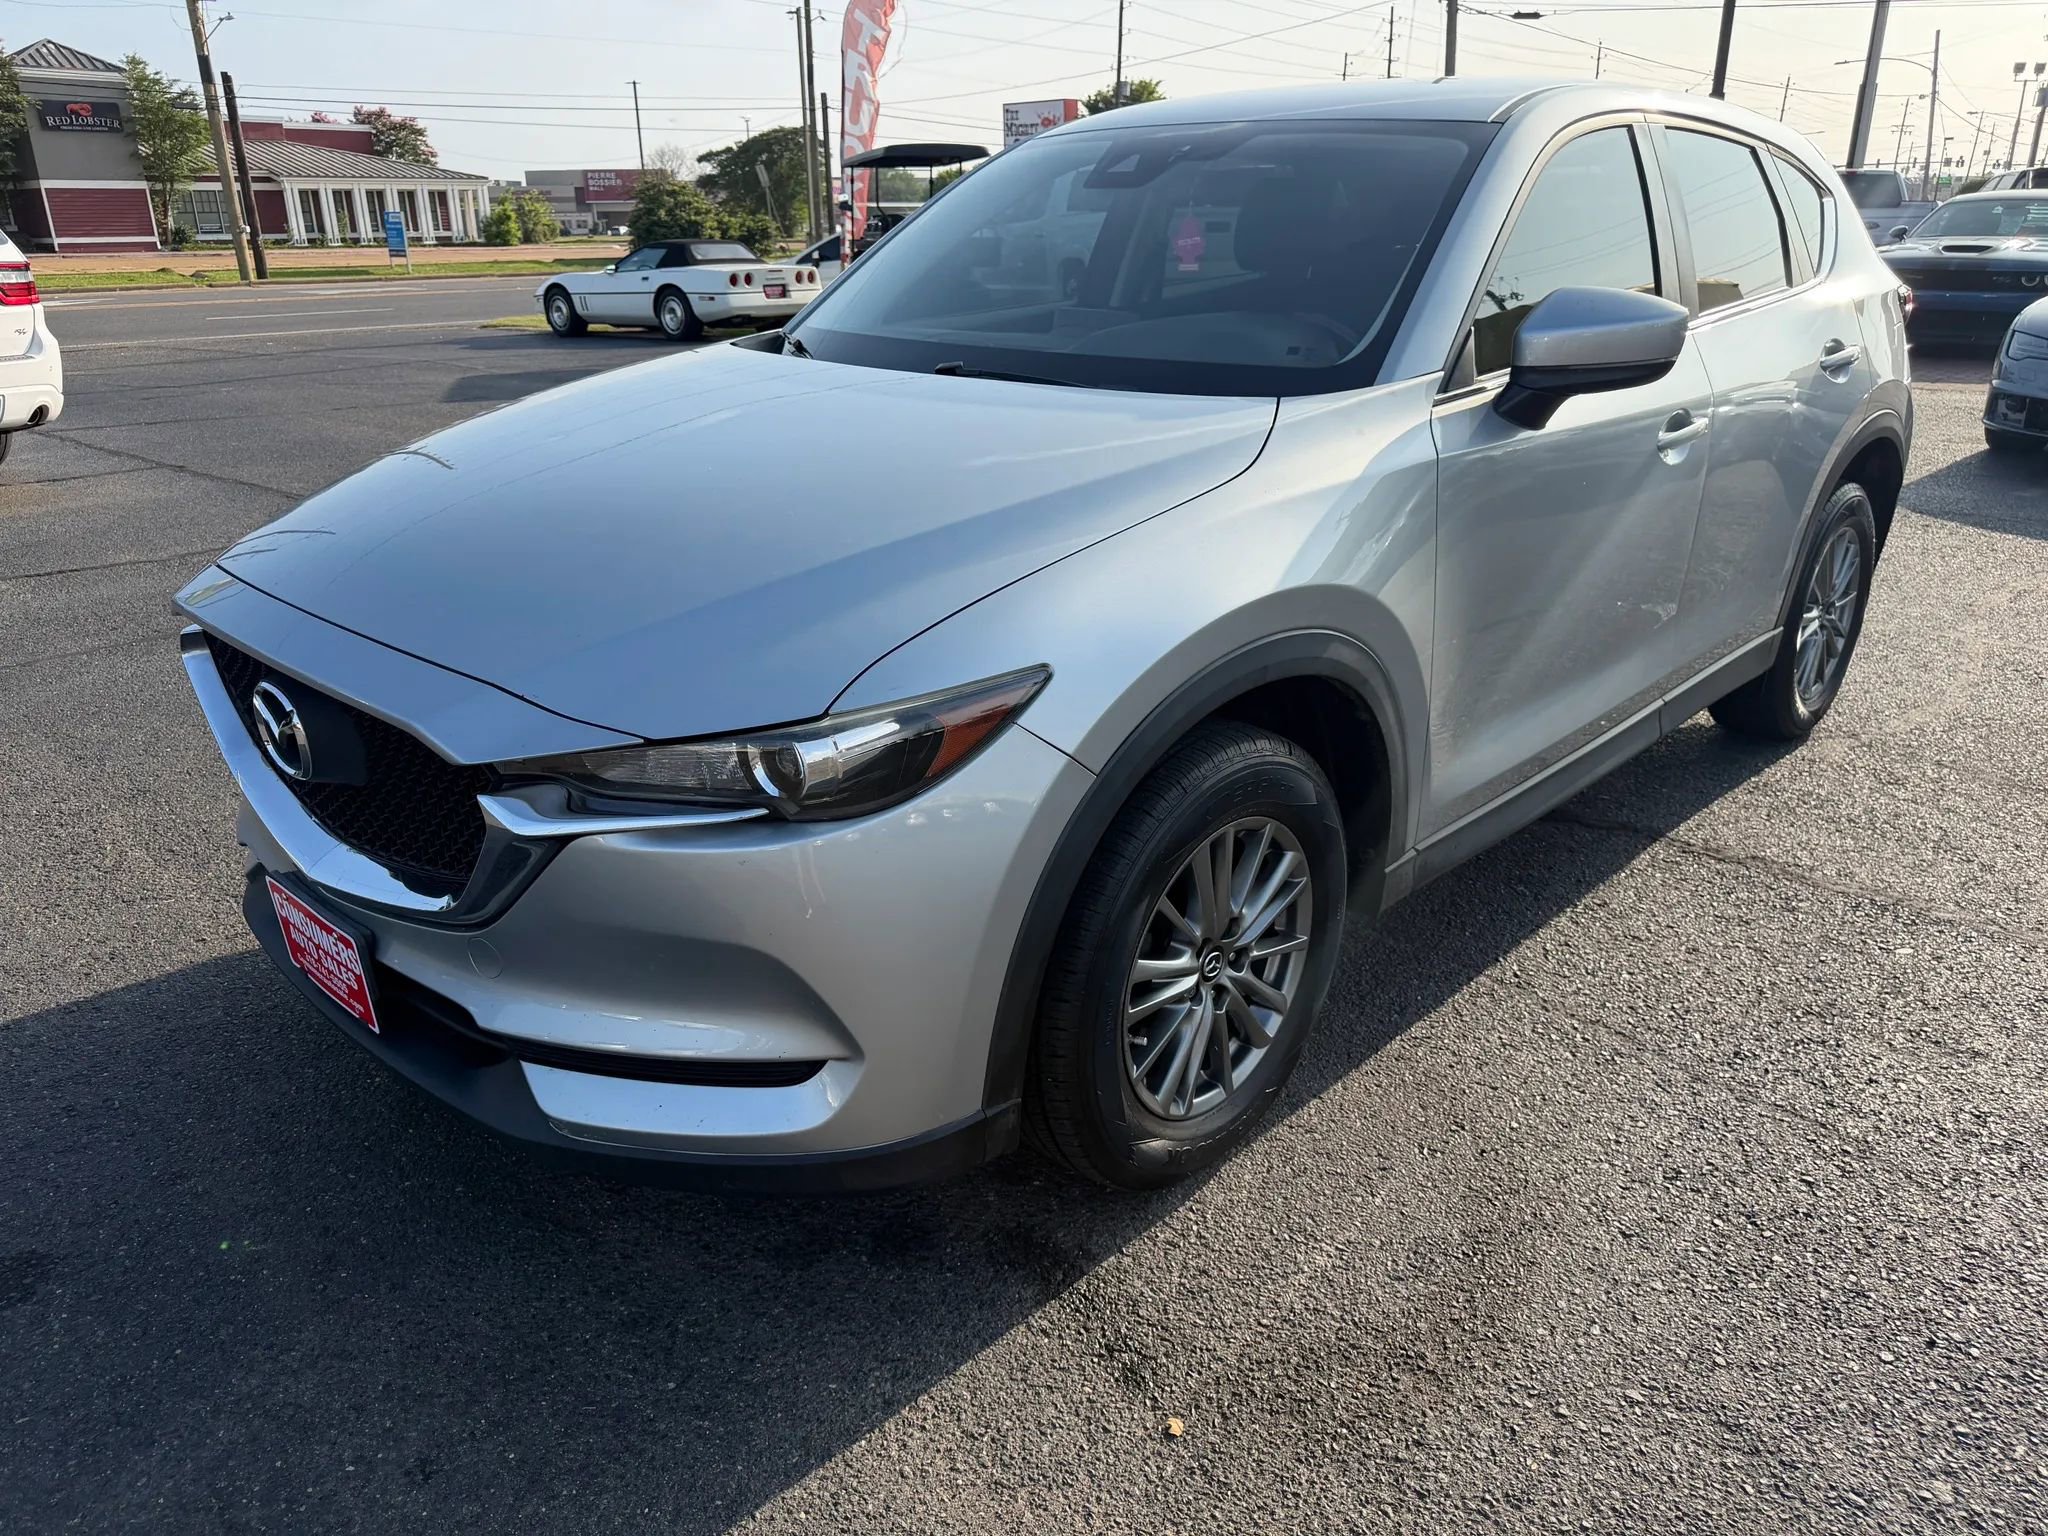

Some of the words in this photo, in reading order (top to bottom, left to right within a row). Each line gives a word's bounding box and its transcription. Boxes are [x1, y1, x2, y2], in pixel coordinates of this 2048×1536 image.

[45, 116, 70, 126] RED
[72, 115, 120, 128] LOBSTER
[273, 892, 361, 976] CONSUMERS
[290, 926, 319, 959] AUTO
[318, 949, 359, 990] SALES
